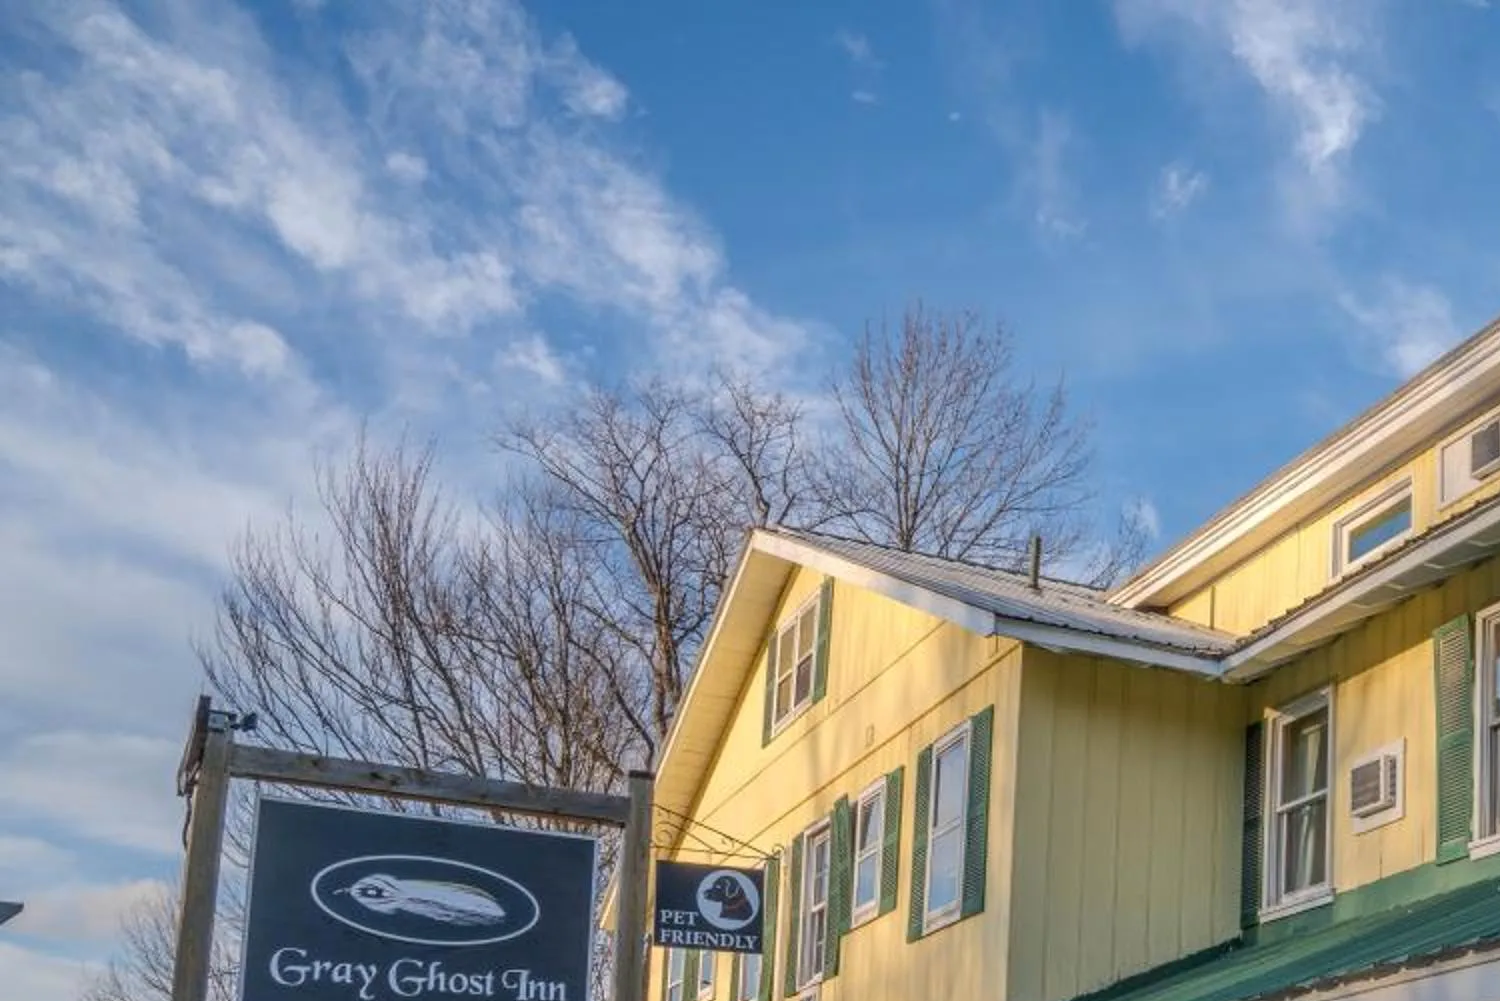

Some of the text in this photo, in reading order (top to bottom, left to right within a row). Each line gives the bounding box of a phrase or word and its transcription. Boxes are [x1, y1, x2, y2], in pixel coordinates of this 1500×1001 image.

[660, 909, 699, 926] PET
[660, 928, 759, 949] FRIENDLY
[269, 947, 567, 1001] Gray Ghost Inn
